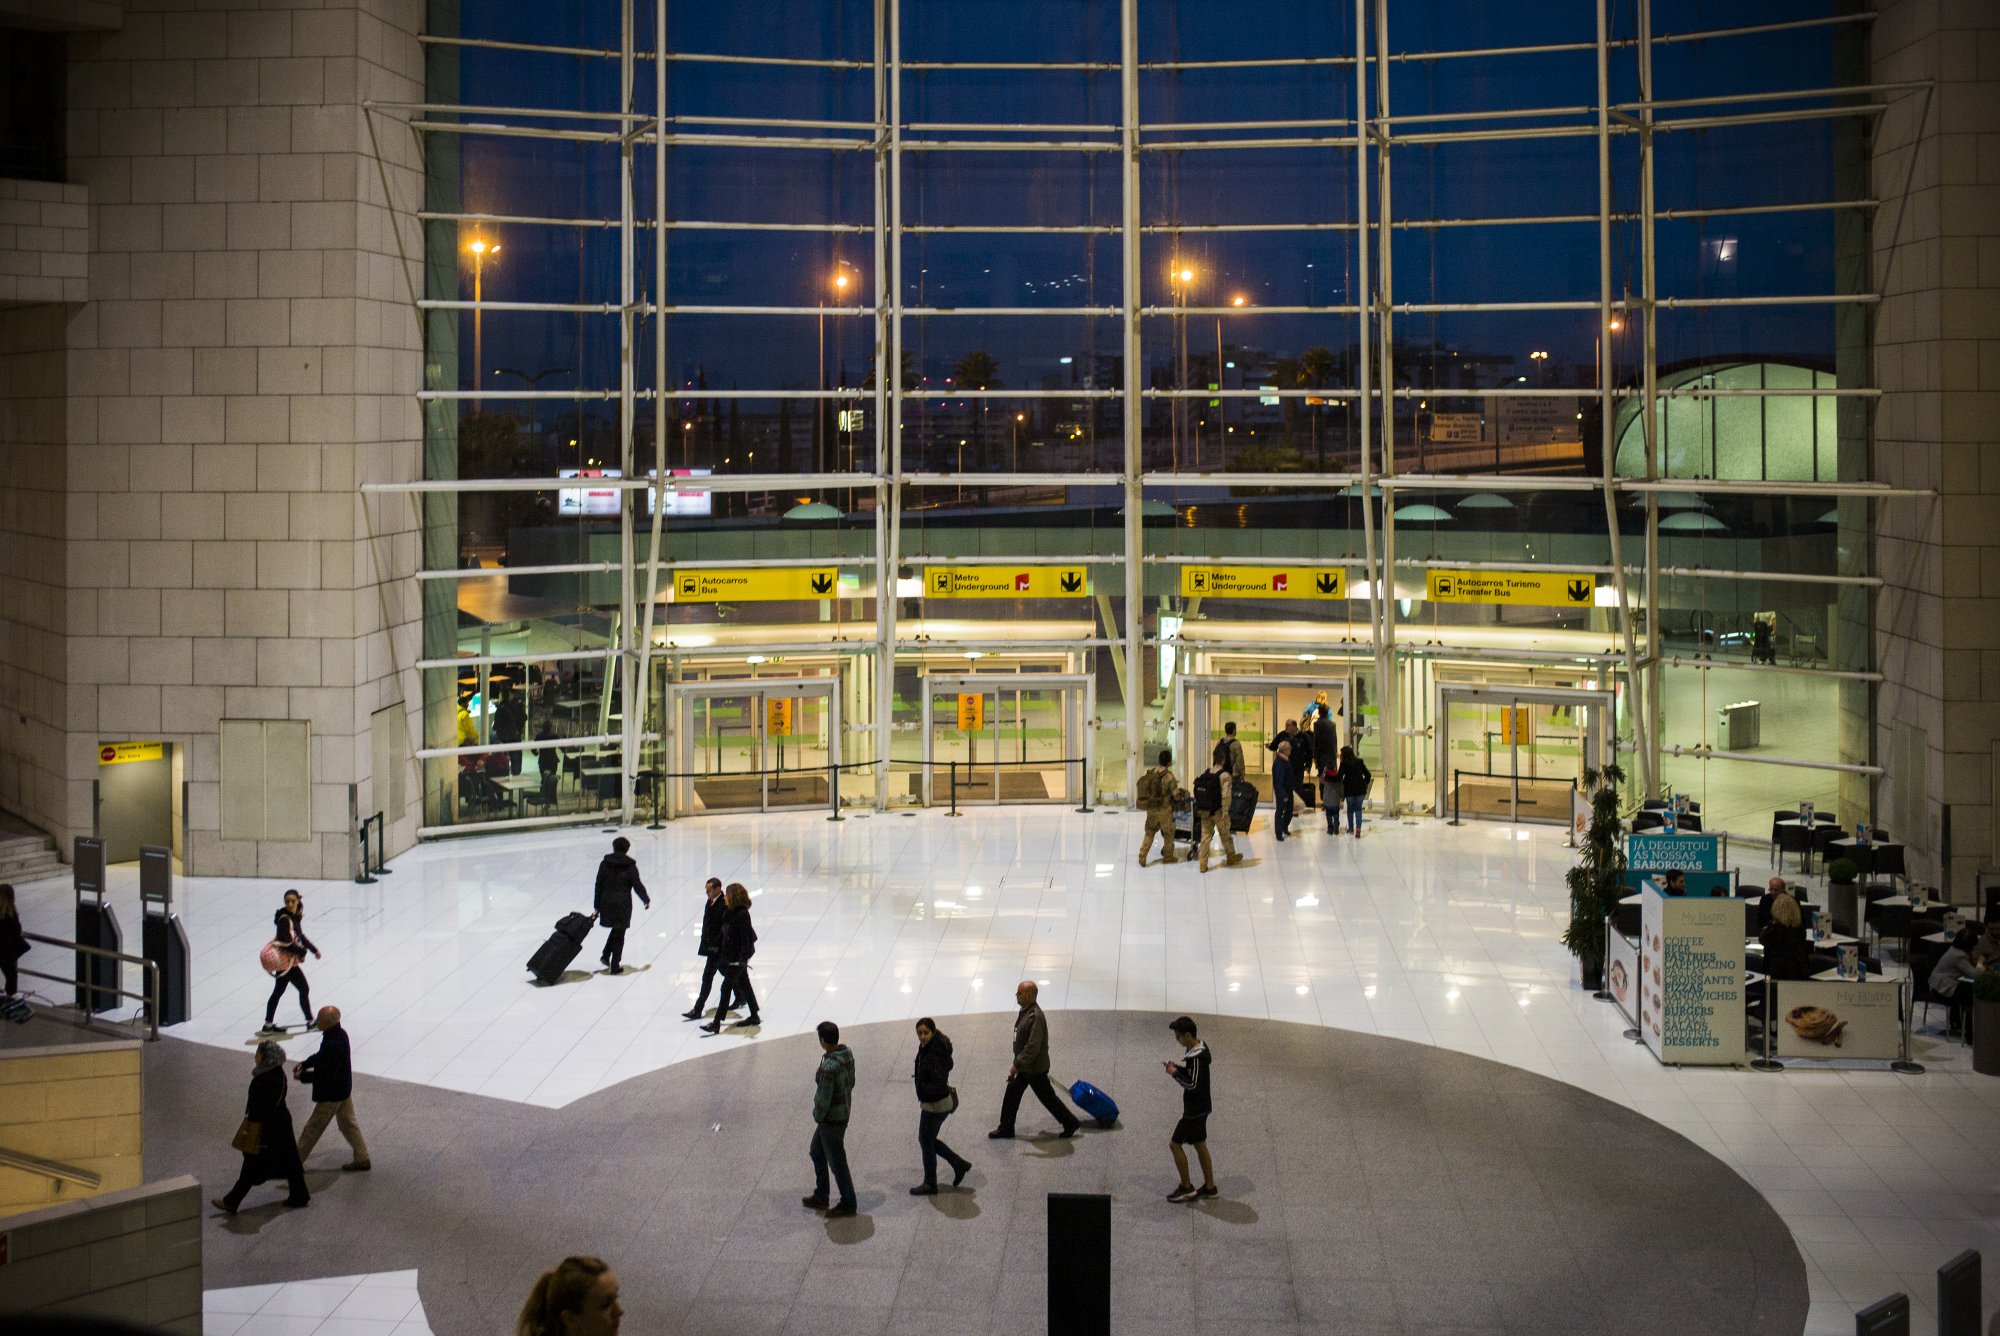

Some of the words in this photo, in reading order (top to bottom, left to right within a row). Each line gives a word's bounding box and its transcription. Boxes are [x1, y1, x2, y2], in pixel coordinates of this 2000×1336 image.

[702, 577, 748, 585] Autocarros
[954, 574, 979, 582] Metro
[1212, 573, 1236, 581] Metro
[954, 583, 1009, 592] Underground
[1212, 582, 1267, 591] Underground
[1457, 578, 1503, 587] Autocarros
[1506, 579, 1541, 588] Turismo
[702, 586, 718, 594] Bus
[1458, 587, 1493, 596] Transfer
[1495, 589, 1511, 597] Bus
[1633, 838, 1645, 851] JÁ
[1649, 840, 1710, 851] DEGUSTOU
[1633, 850, 1649, 860] AS
[1651, 850, 1697, 860] NOSSAS
[1633, 860, 1703, 870] SABOROSAS
[1664, 936, 1705, 946] COFFEE
[1664, 944, 1691, 953] BEER
[1664, 952, 1717, 961] PASTRIES
[1664, 960, 1736, 970] CAPPUCCINO
[1664, 968, 1705, 977] PASTAS
[1664, 975, 1734, 985] CROISSANTS
[1664, 983, 1704, 992] PIZZAS
[1664, 991, 1738, 1000] SANDWICHES
[1664, 999, 1703, 1008] WRAPS
[1664, 1007, 1714, 1016] BURGERS
[1664, 1014, 1706, 1023] STEAKS
[1664, 1022, 1708, 1031] SALADS
[1664, 1030, 1712, 1039] CODFISH
[1664, 1037, 1720, 1047] DESSERTS
